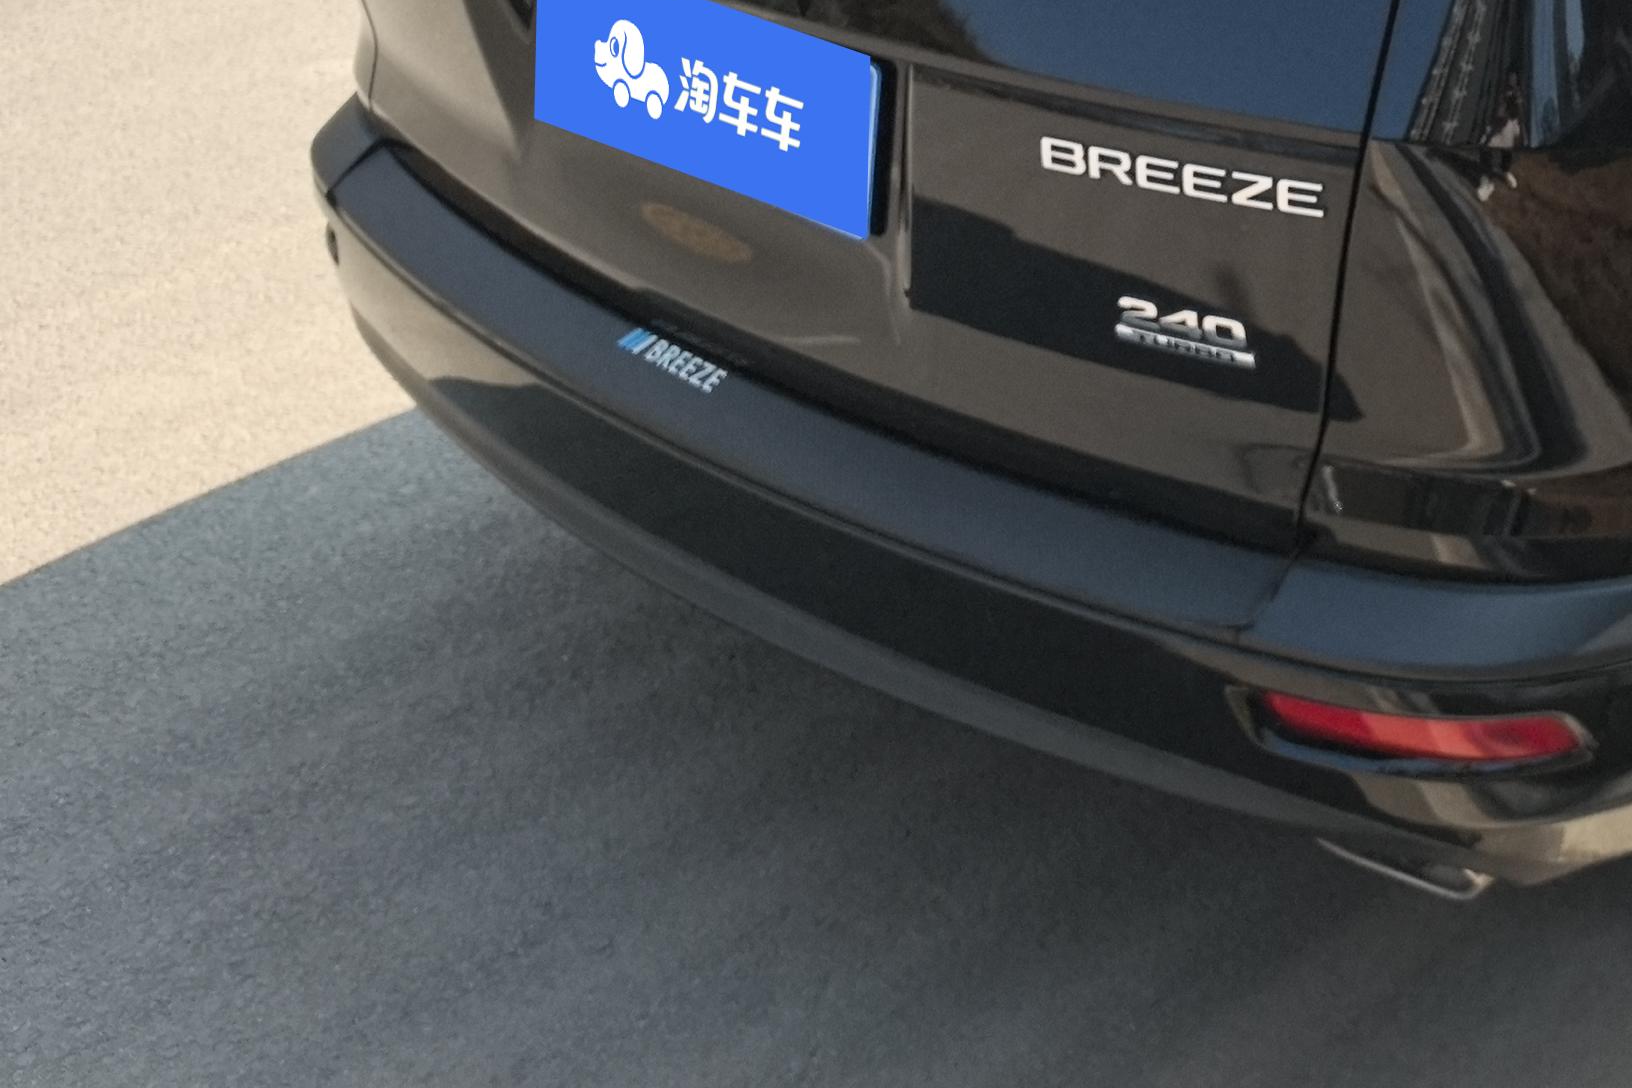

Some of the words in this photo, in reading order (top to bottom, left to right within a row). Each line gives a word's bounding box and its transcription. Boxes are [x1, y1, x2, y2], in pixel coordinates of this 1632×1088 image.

[1040, 136, 1325, 218] BREEZE
[1117, 296, 1248, 349] 240
[644, 338, 728, 393] BREEZE
